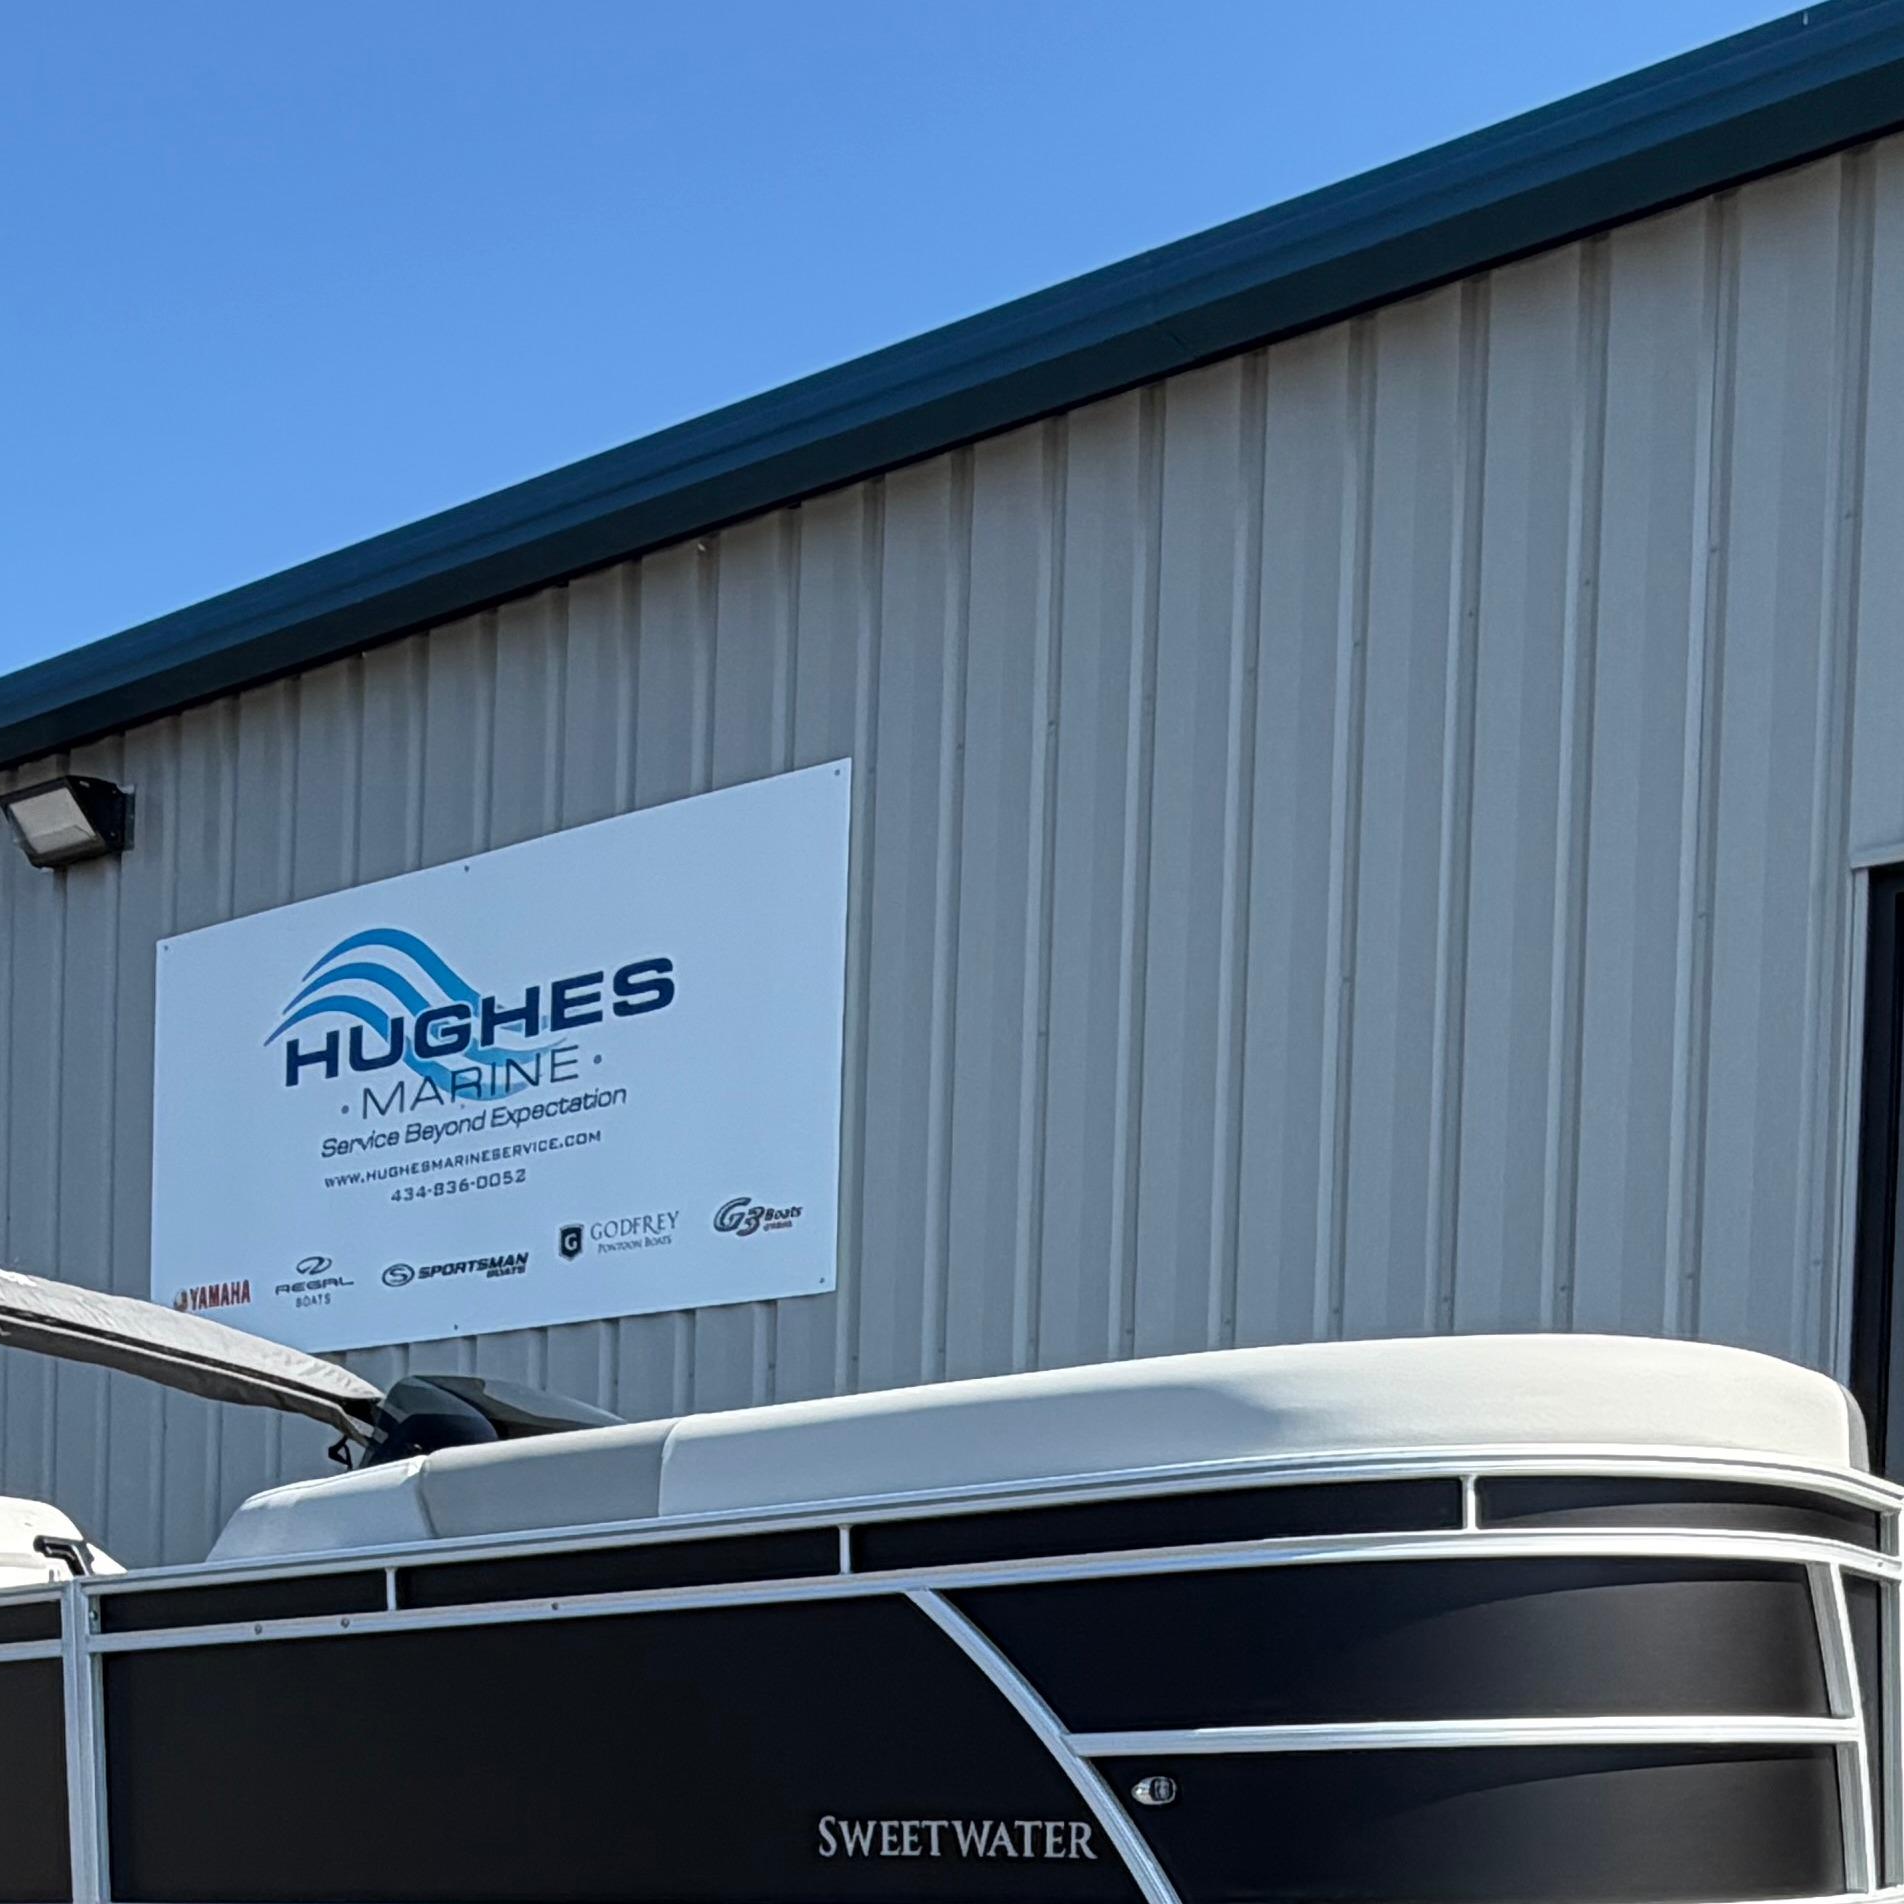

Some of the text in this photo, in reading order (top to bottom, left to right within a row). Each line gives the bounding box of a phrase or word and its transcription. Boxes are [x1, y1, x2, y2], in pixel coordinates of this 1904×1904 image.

[285, 957, 676, 1087] HUGHES
[363, 1045, 579, 1119] MARINE
[321, 1087, 627, 1158] Service Beyond Expectation
[391, 1169, 527, 1202] 434-836-0052
[590, 1210, 679, 1241] GODFREY
[418, 1252, 529, 1280] SPORTSMAN
[189, 1279, 251, 1310] YAMAHA
[275, 1277, 354, 1295] REGAL
[295, 1293, 331, 1308] BOATS
